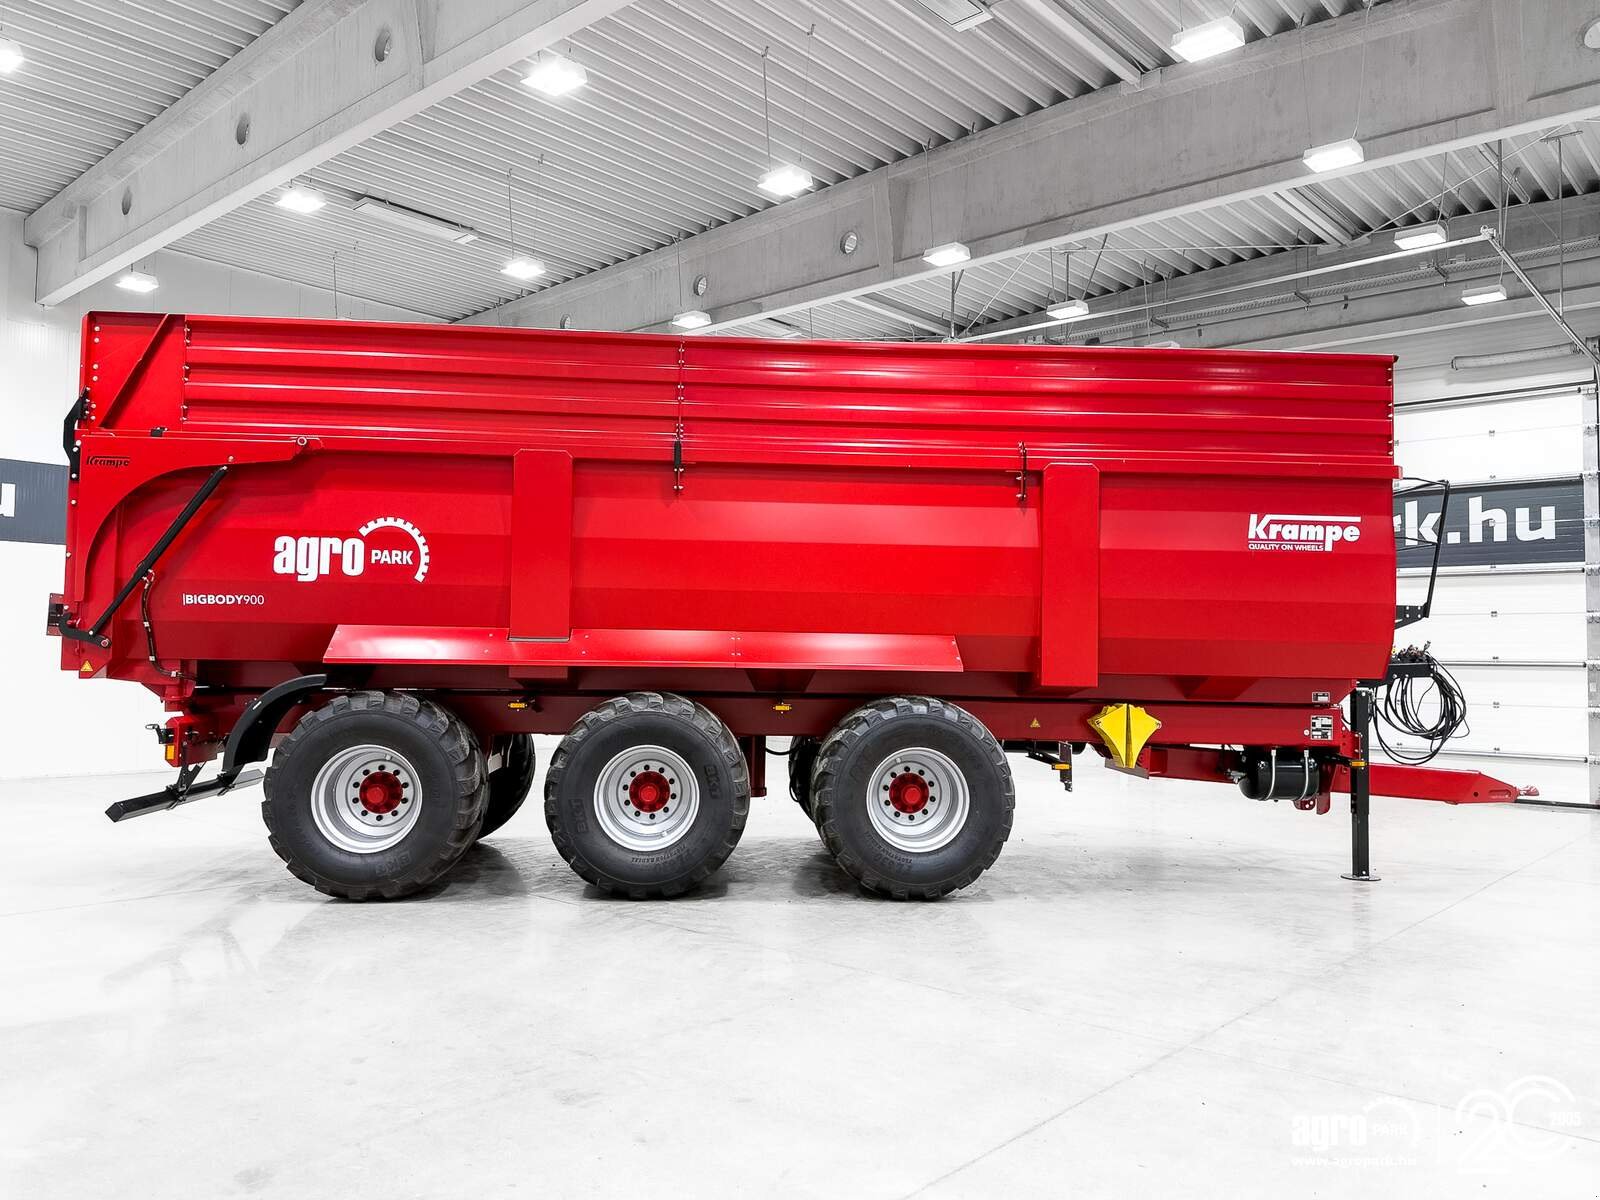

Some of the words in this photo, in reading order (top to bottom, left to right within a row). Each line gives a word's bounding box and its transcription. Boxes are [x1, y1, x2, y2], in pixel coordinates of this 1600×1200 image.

[86, 456, 130, 468] Krampe
[1248, 513, 1361, 552] Krampe
[273, 535, 365, 582] agro
[371, 549, 413, 565] PARK
[1248, 543, 1280, 551] QUALITY
[1295, 544, 1324, 552] WHEELS
